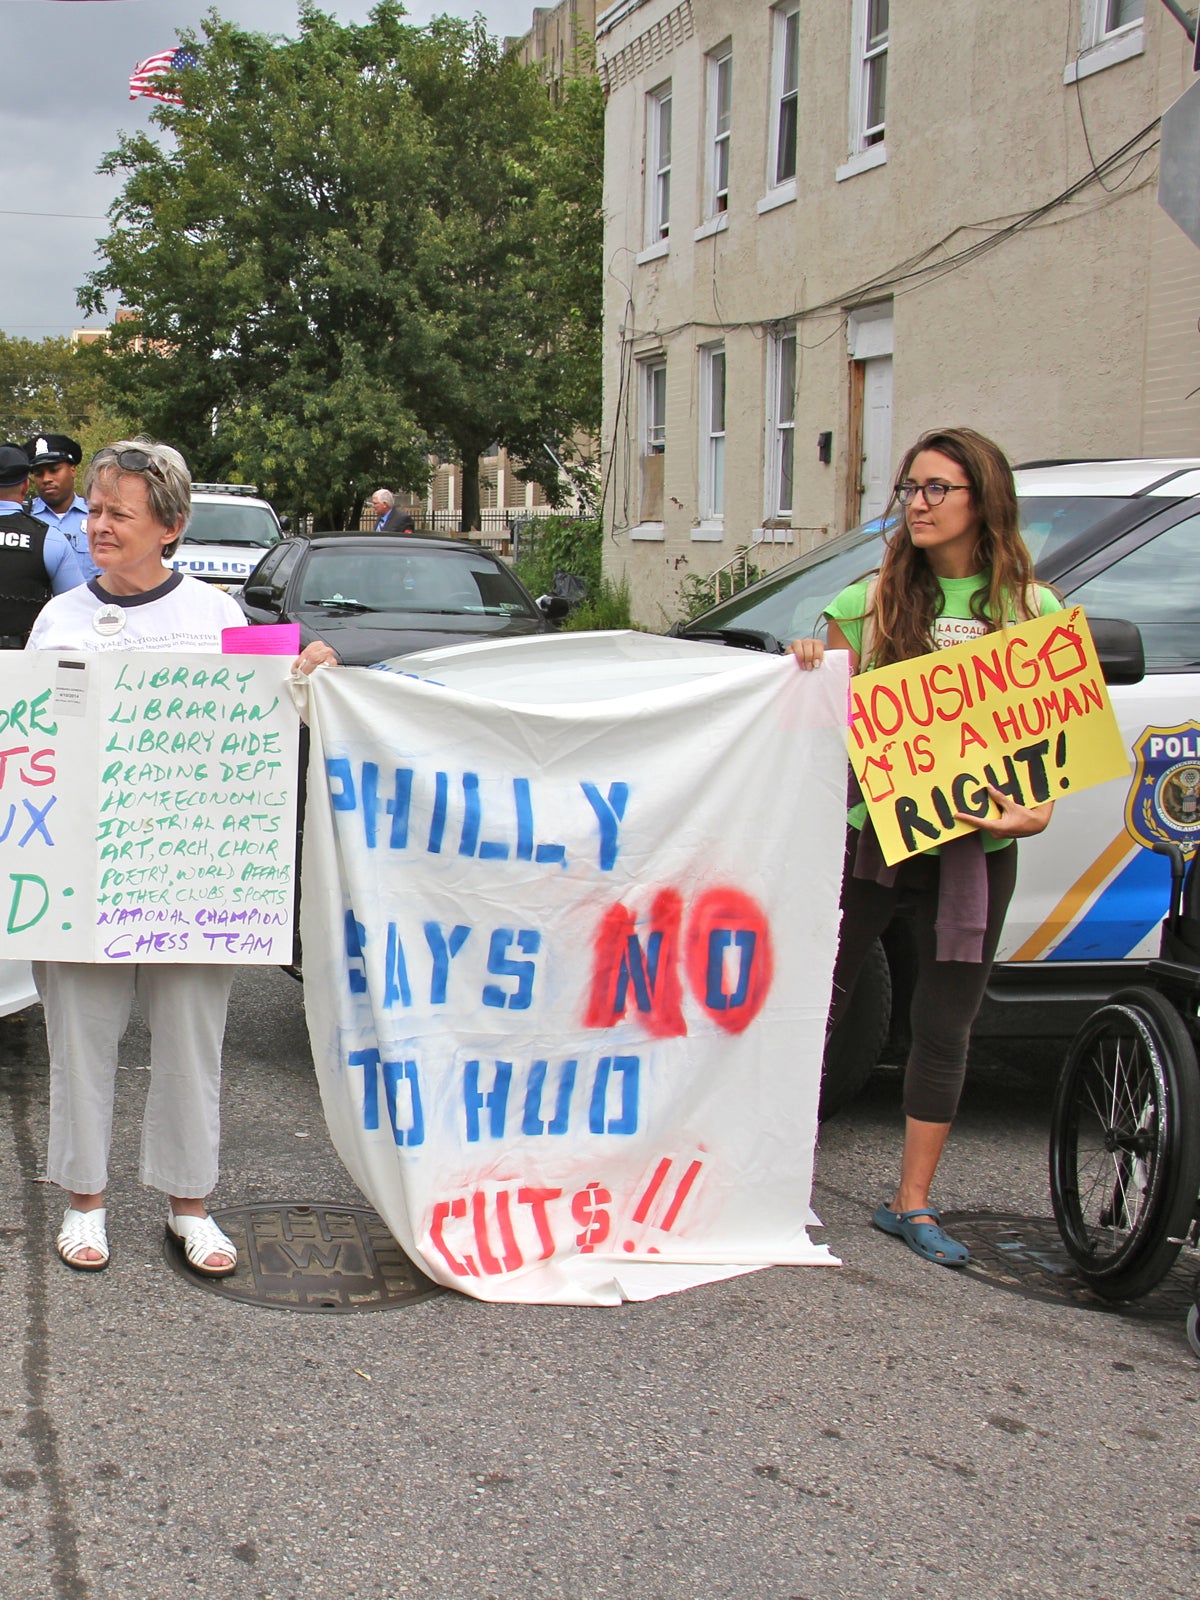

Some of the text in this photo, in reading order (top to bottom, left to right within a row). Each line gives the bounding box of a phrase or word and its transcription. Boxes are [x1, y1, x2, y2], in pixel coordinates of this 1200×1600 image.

[101, 641, 122, 649] YALE
[124, 636, 170, 646] NATIONAL
[171, 632, 218, 641] INITIATIVE
[938, 624, 952, 633] LA
[114, 664, 255, 694] LIBRARY
[849, 637, 1041, 750] HOUSING
[108, 696, 279, 723] LIBRARIAN
[903, 679, 1105, 776] IS A HUMAN
[105, 729, 282, 756] LIBRARY AIDE
[102, 759, 282, 786] READING DEPT
[894, 730, 1070, 853] RIGHT!
[222, 814, 281, 833] ARTS
[325, 757, 628, 871] PHILLY
[218, 839, 279, 861] CHOIR
[176, 863, 235, 880] WORLD
[232, 886, 288, 905] SPORTS
[96, 908, 288, 927] NATIONAL CHAMPION
[104, 931, 273, 958] CHESS TEAM
[345, 888, 774, 1036] SAYS NO
[347, 1048, 641, 1147] TO HUD
